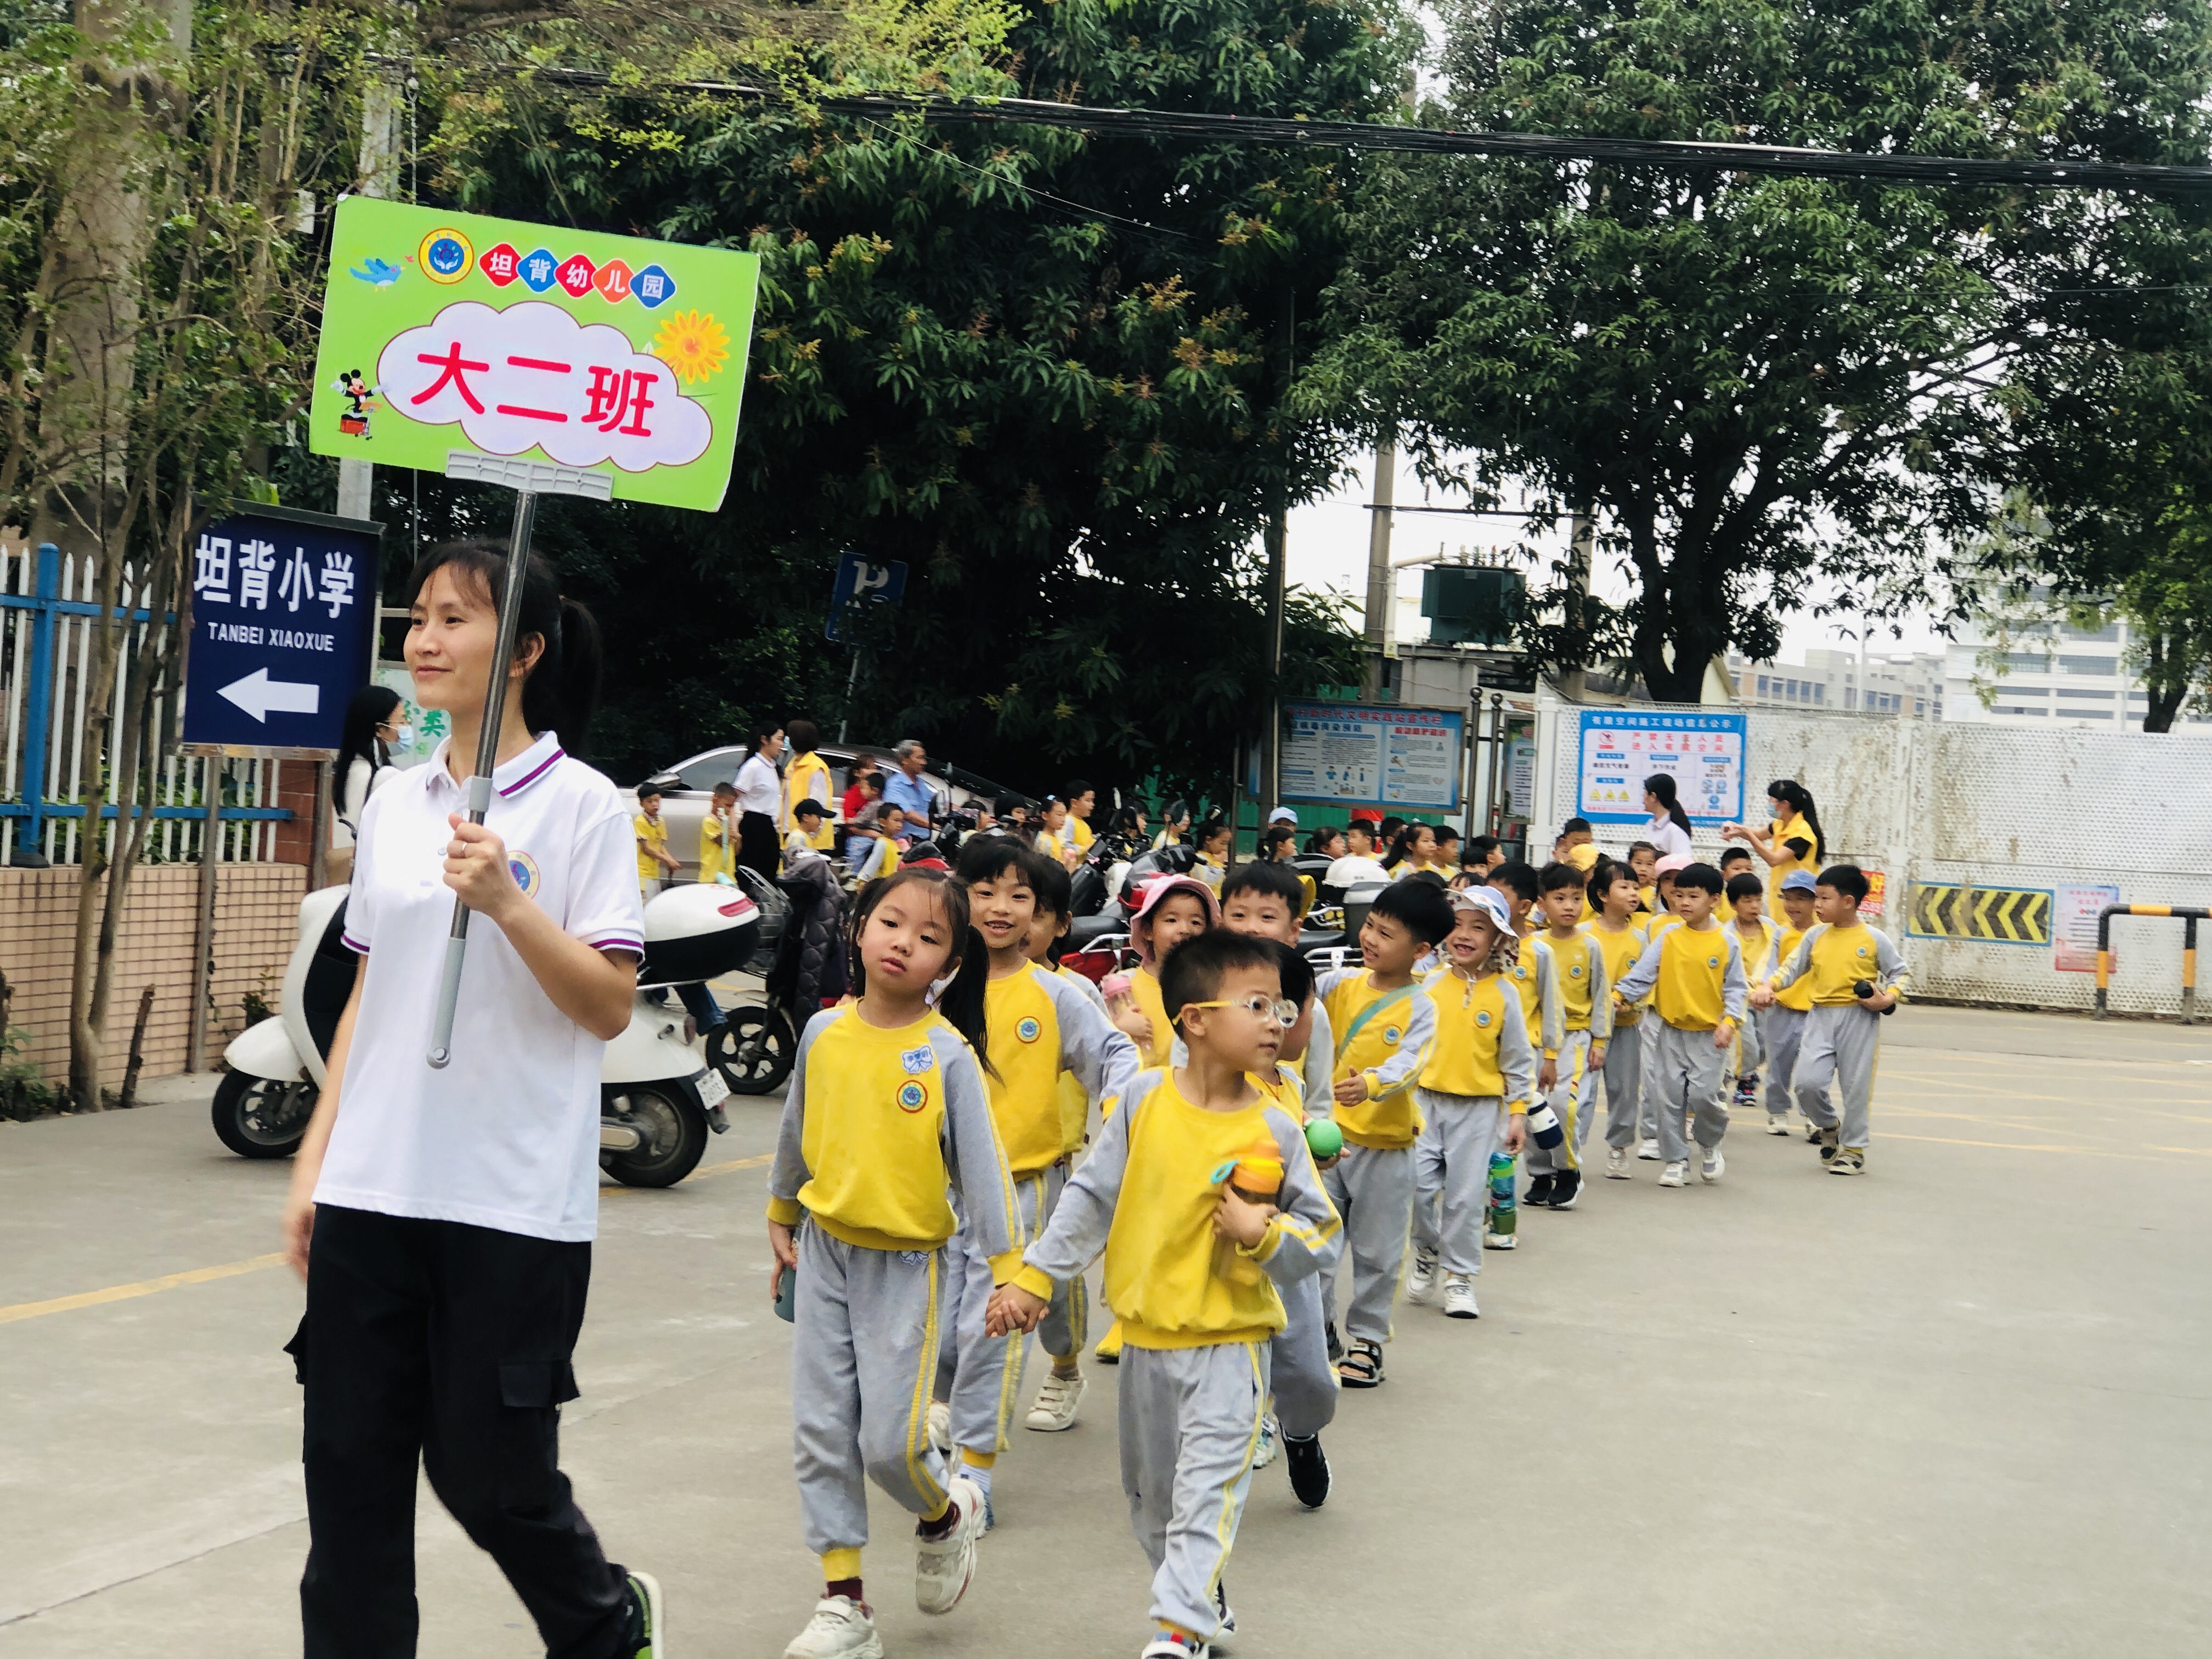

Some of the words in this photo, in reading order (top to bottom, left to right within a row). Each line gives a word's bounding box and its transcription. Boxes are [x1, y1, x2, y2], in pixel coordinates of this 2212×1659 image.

[489, 252, 664, 299] 坦背幼儿园
[411, 341, 659, 437] 大二班
[193, 534, 354, 619] 坦背小学
[845, 560, 889, 608] P
[207, 622, 264, 645] TANBEI
[269, 628, 335, 652] XIAOXUE
